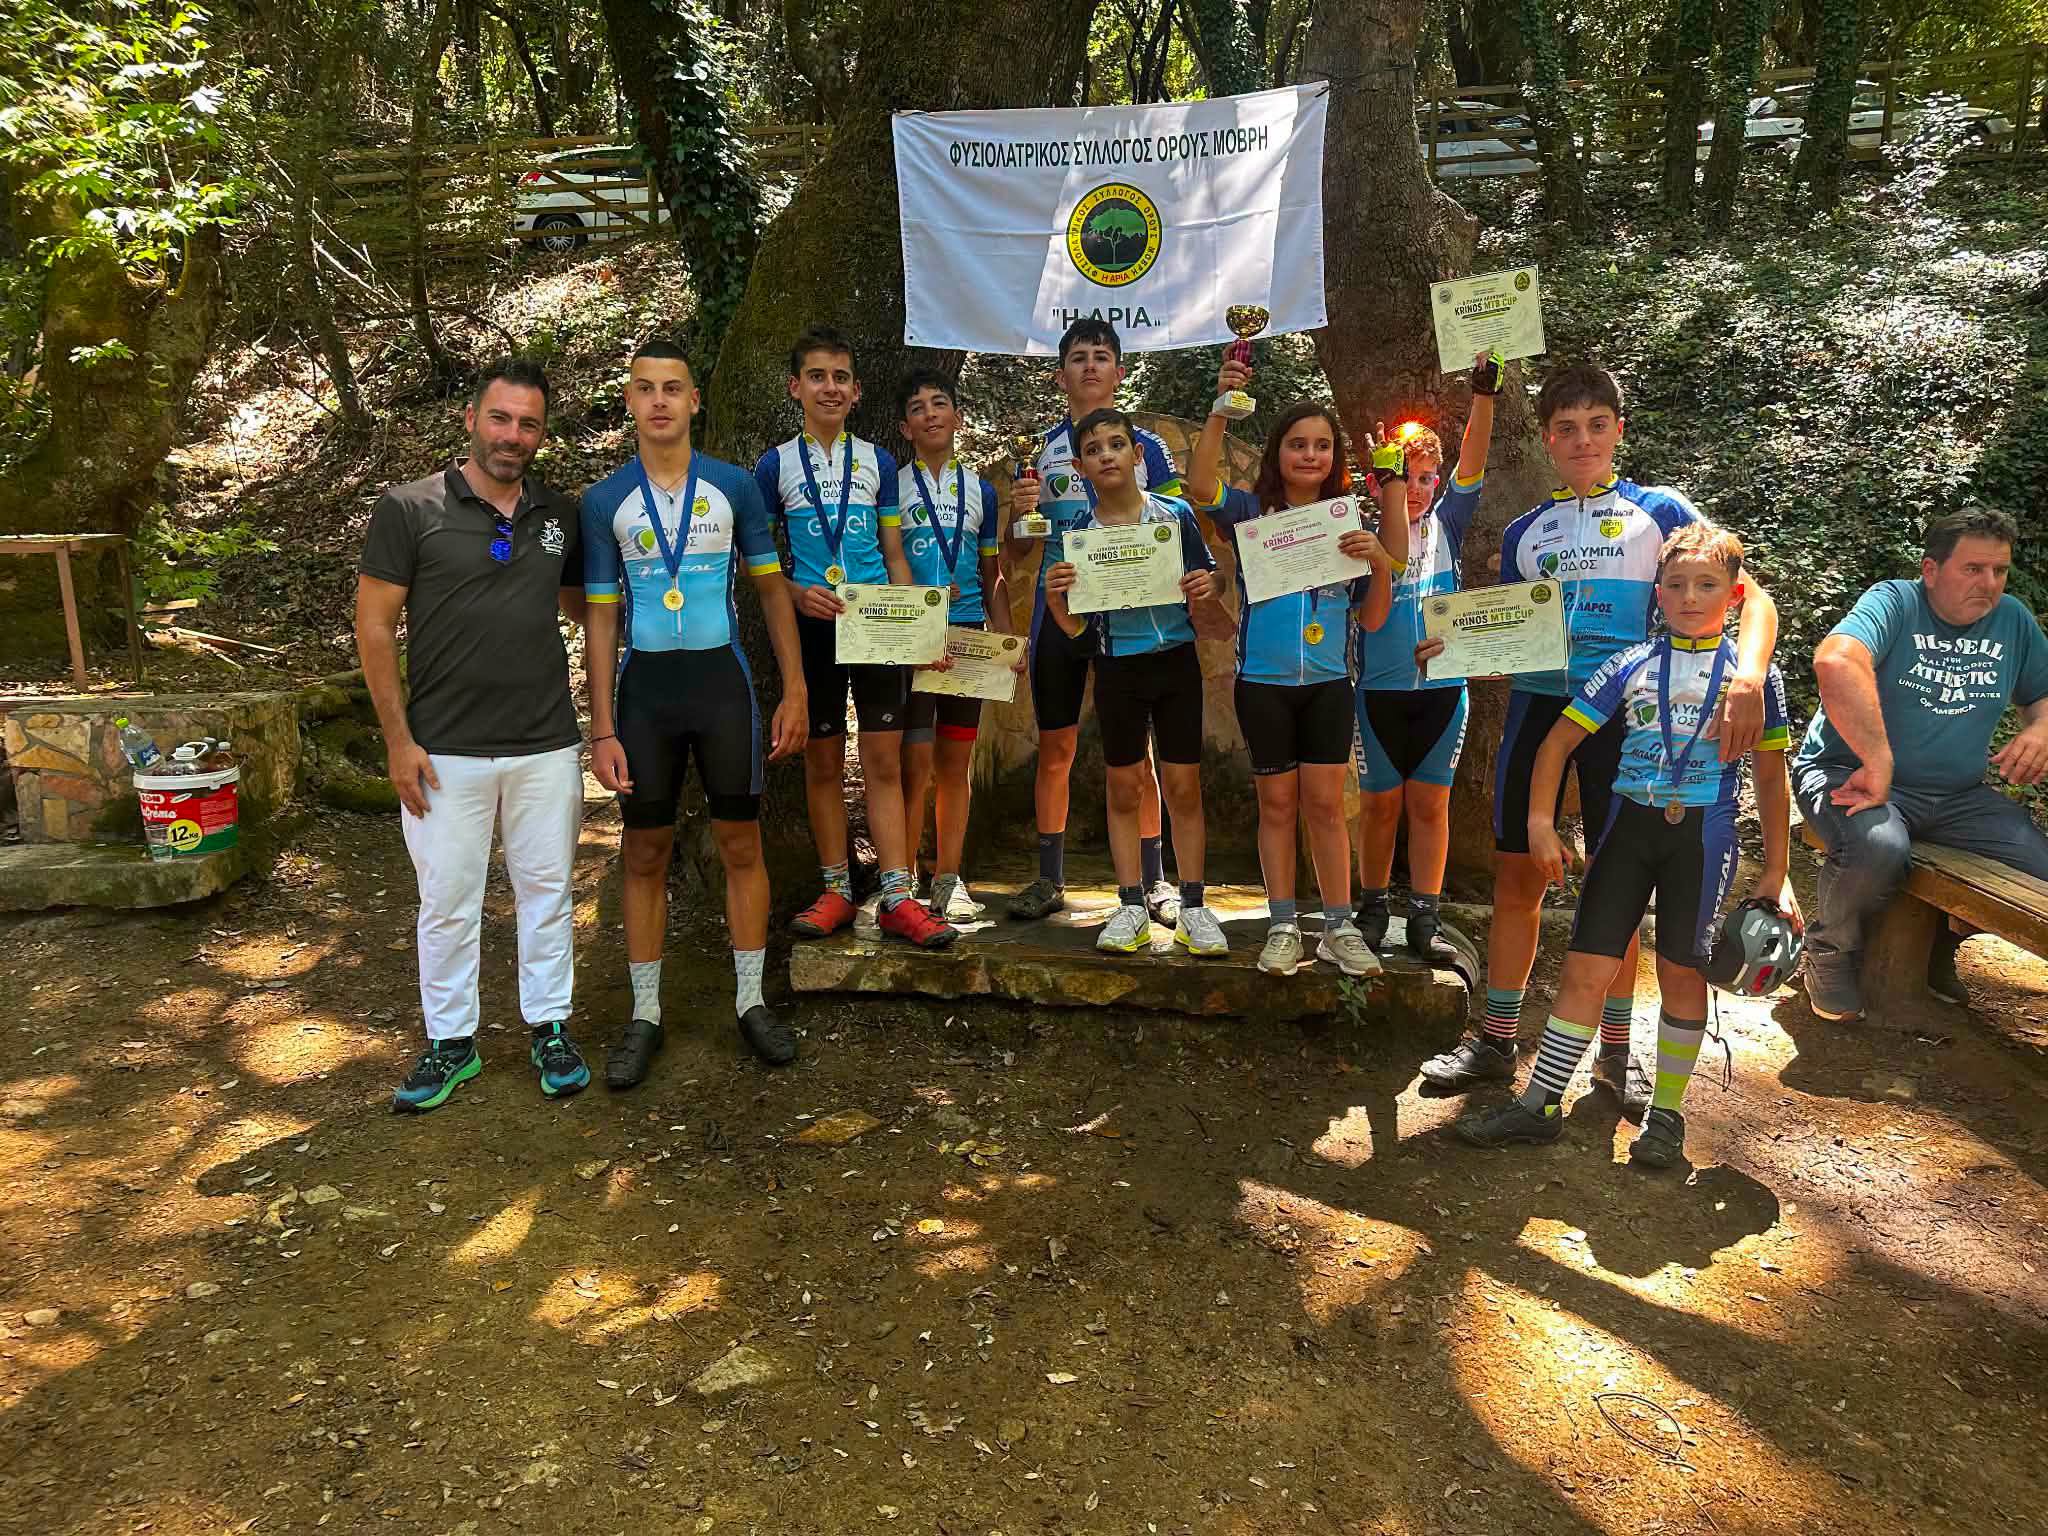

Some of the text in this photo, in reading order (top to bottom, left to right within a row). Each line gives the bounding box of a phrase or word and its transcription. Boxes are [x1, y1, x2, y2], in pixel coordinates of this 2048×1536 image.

[949, 125, 1268, 168] ΦΥΣΙΟΛΑΤΡΙΚΟΣ ΣΥΛΛΟΓΟΣ ΟΡΟΥΣ ΜΟΒΡΗ
[1454, 303, 1483, 316] KRINOS
[1263, 534, 1295, 549] KRINOS
[1088, 550, 1118, 561] KRINOS
[1120, 548, 1138, 558] MTB
[1140, 546, 1157, 556] CUP
[1560, 546, 1625, 560] ΟΛΥΜΠΙΑ
[1560, 560, 1598, 572] ΟΔΟΣ
[858, 607, 926, 617] KRINOS MTB CUP
[1453, 608, 1535, 627] KRINOS MTB CUP
[1898, 678, 1932, 693] UNITED
[1920, 697, 1977, 715] OF AMERICA
[171, 825, 189, 843] 12
